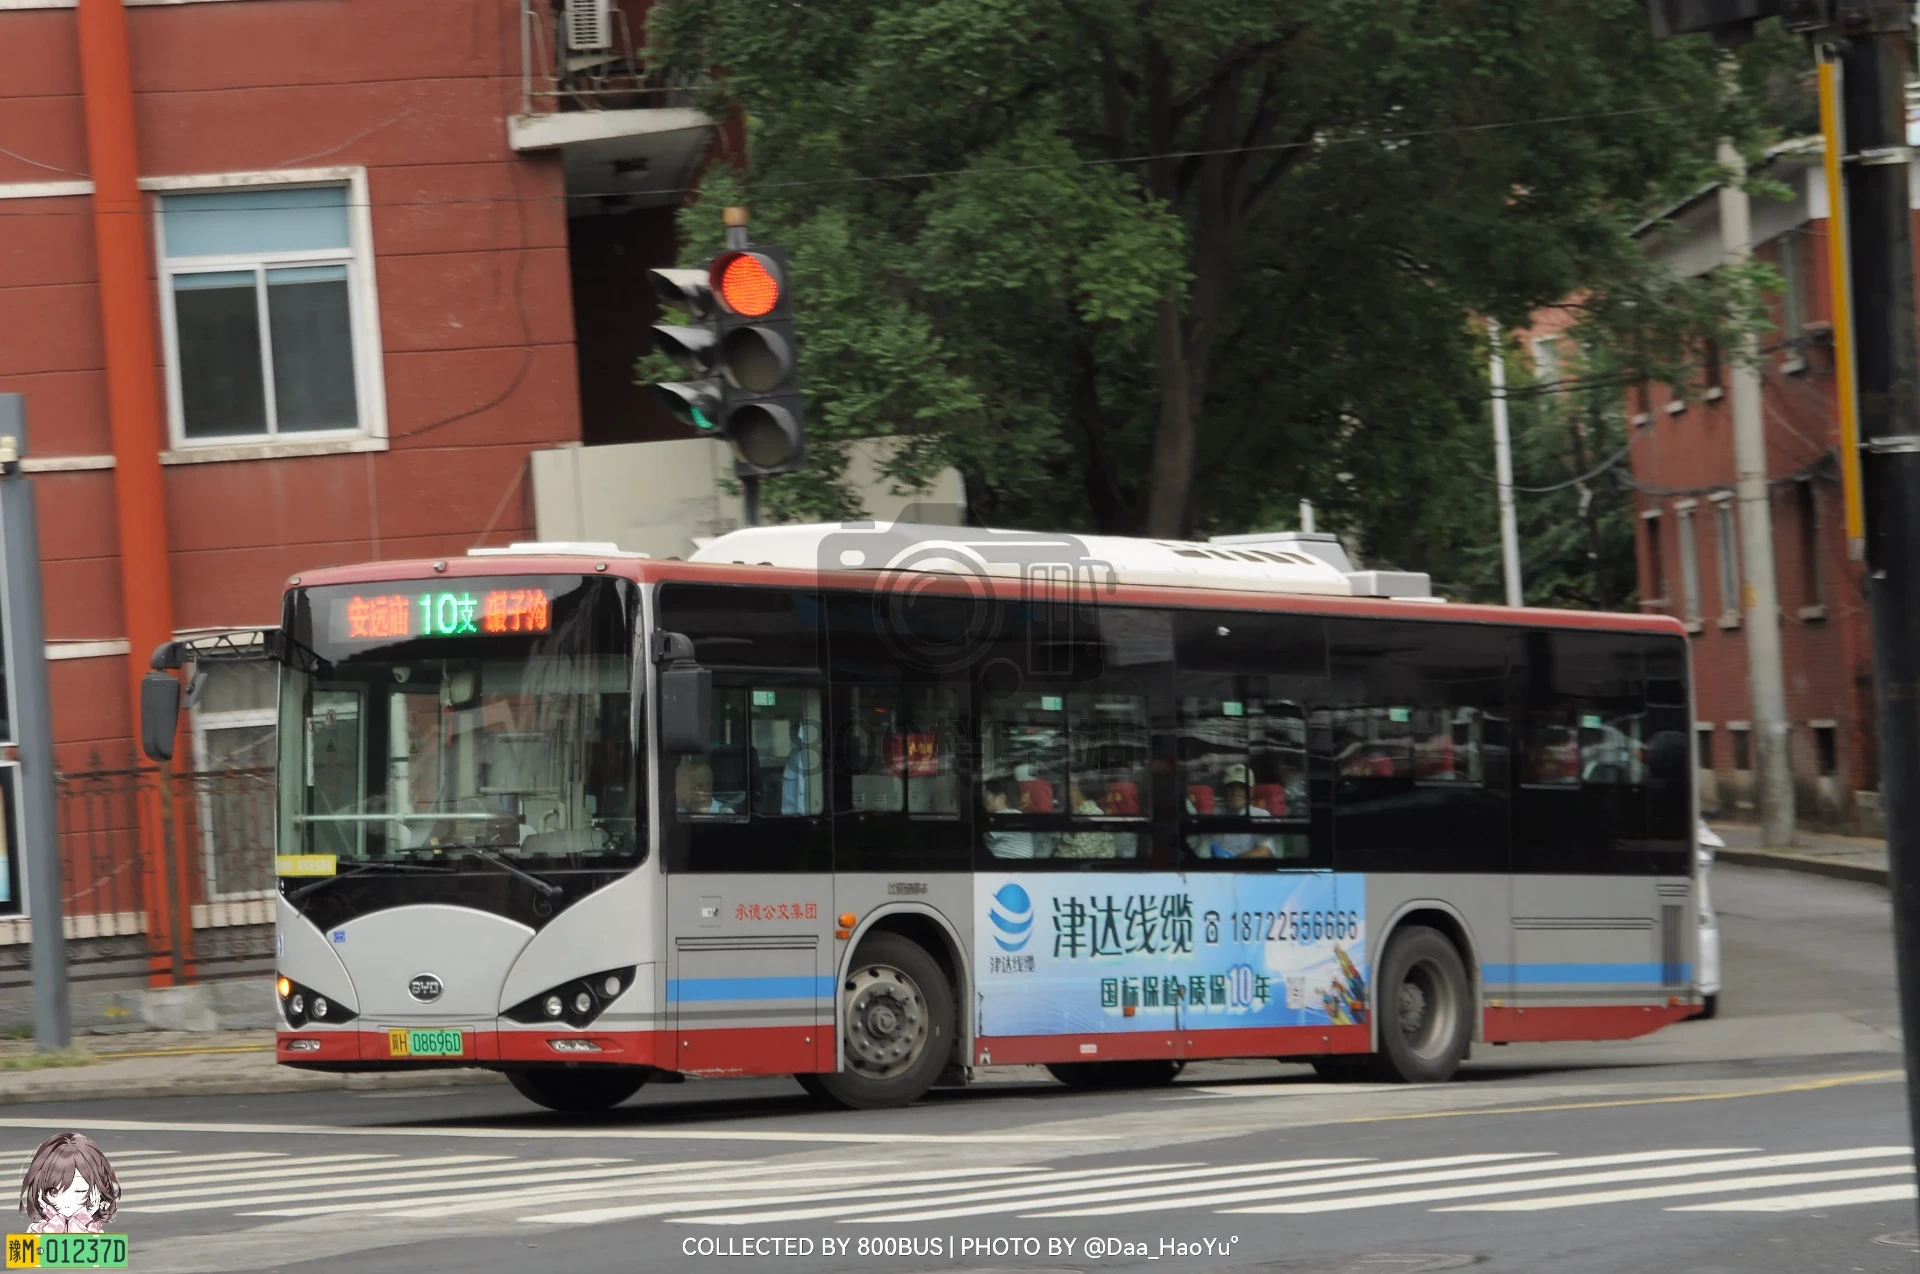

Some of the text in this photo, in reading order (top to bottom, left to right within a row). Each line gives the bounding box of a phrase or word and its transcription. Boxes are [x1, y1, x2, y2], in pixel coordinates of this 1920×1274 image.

[348, 595, 410, 638] 安远庙
[419, 592, 479, 635] 10支
[735, 903, 817, 921] 承德公交集团
[1052, 894, 1195, 957] 津达线缆
[1231, 911, 1358, 942] 18722556666
[990, 955, 1035, 973] 津达线缆
[411, 981, 439, 994] BYD
